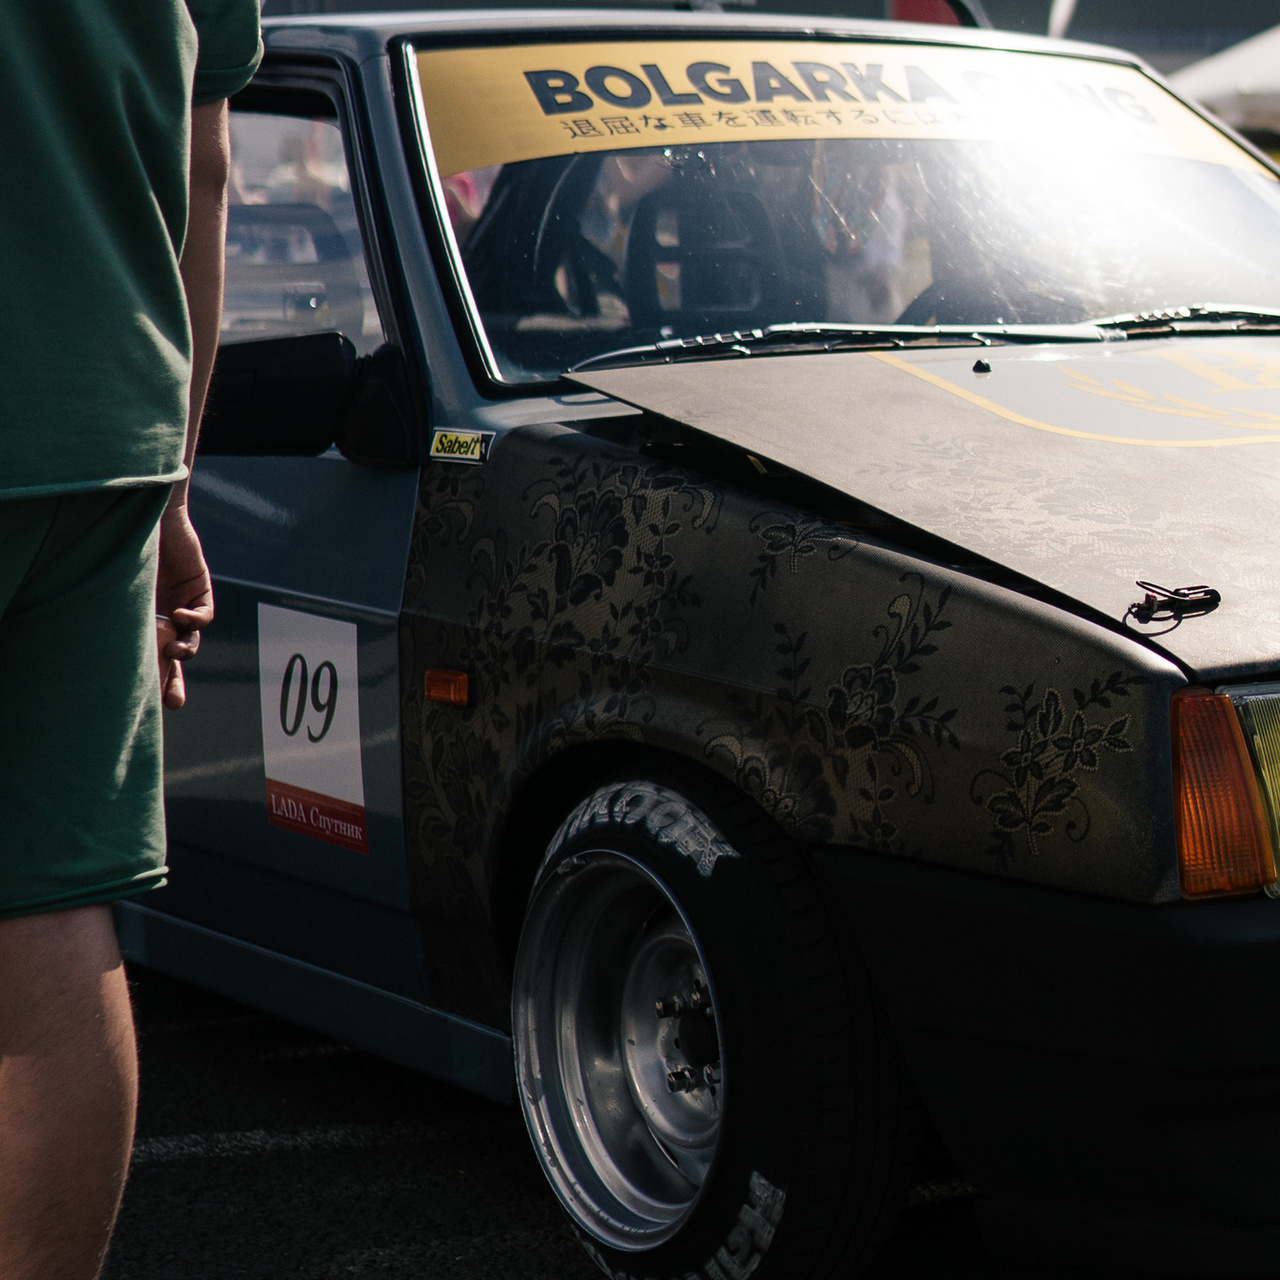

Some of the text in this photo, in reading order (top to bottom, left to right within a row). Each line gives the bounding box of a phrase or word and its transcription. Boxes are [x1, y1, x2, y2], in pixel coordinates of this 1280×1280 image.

[523, 61, 959, 117] BOLGARKA
[435, 433, 480, 456] Sabelt
[280, 652, 339, 744] 09
[271, 793, 363, 840] LADA Спутник
